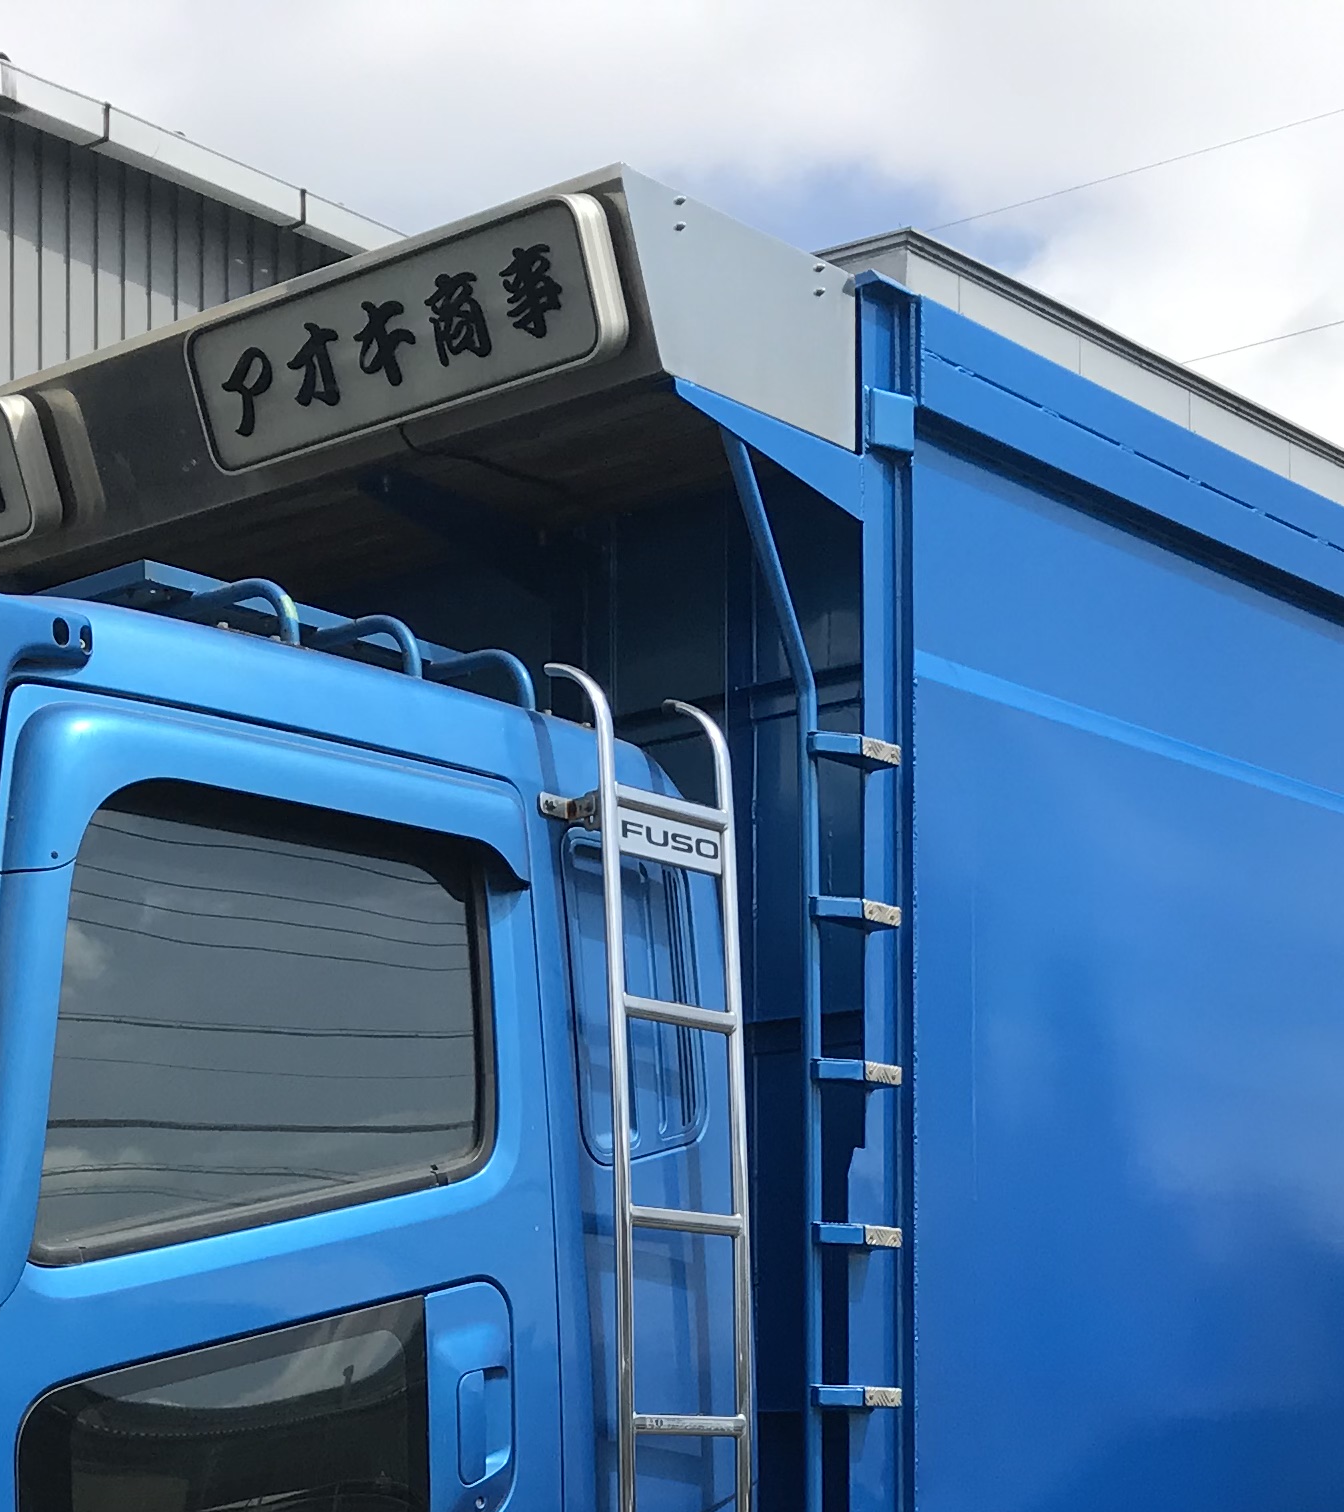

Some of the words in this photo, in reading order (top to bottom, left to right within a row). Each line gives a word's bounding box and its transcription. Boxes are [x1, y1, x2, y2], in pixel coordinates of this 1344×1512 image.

[221, 244, 562, 437] アオキ商事
[621, 819, 719, 860] FUSO
